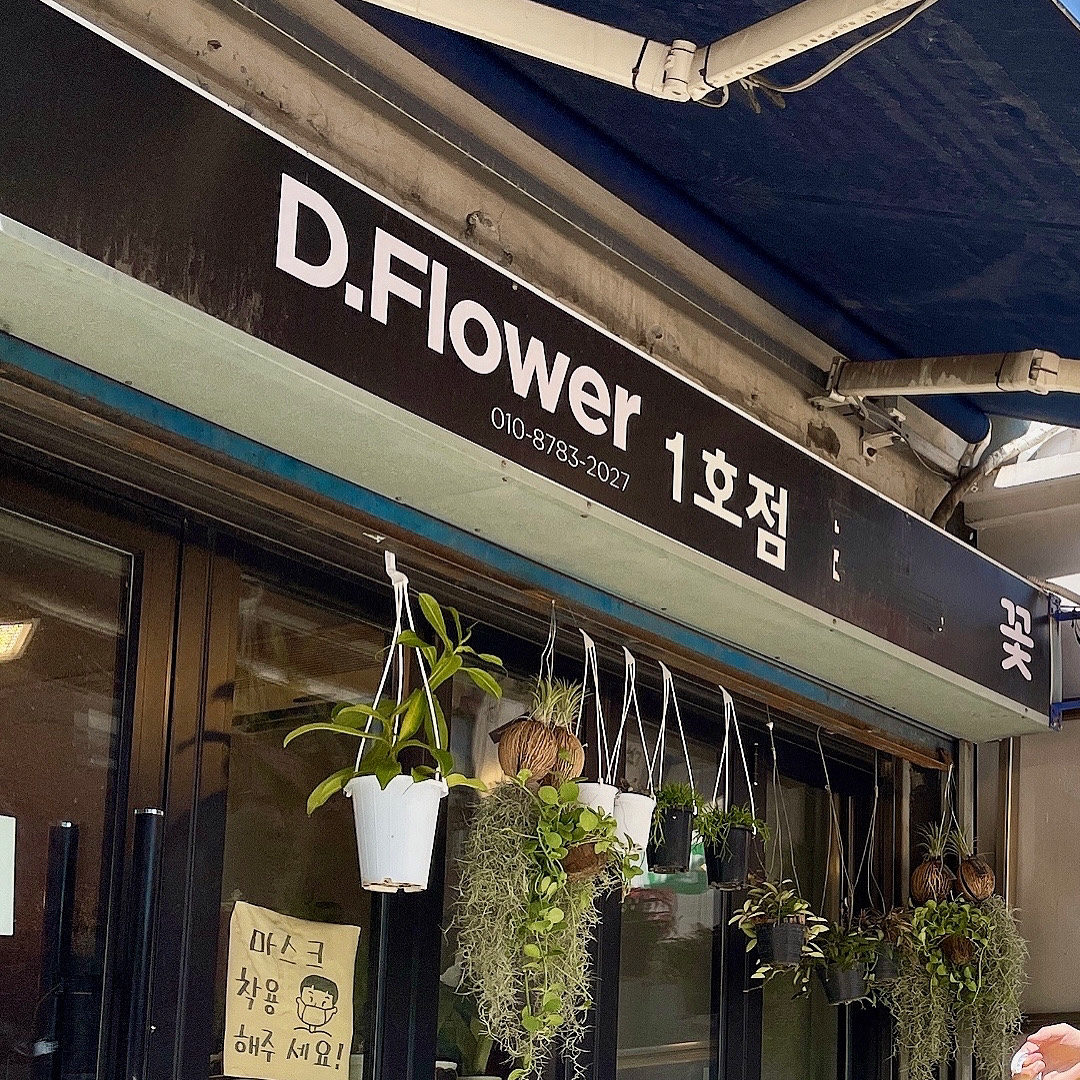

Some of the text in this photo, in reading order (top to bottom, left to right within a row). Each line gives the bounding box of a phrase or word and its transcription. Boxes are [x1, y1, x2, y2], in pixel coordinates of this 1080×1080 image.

[275, 173, 642, 452] D.Flower
[489, 405, 632, 493] 010-8783-2027
[664, 431, 790, 571] 1호점
[999, 596, 1036, 682] 꽃
[234, 966, 280, 1016] 착용
[249, 928, 325, 970] 마스크
